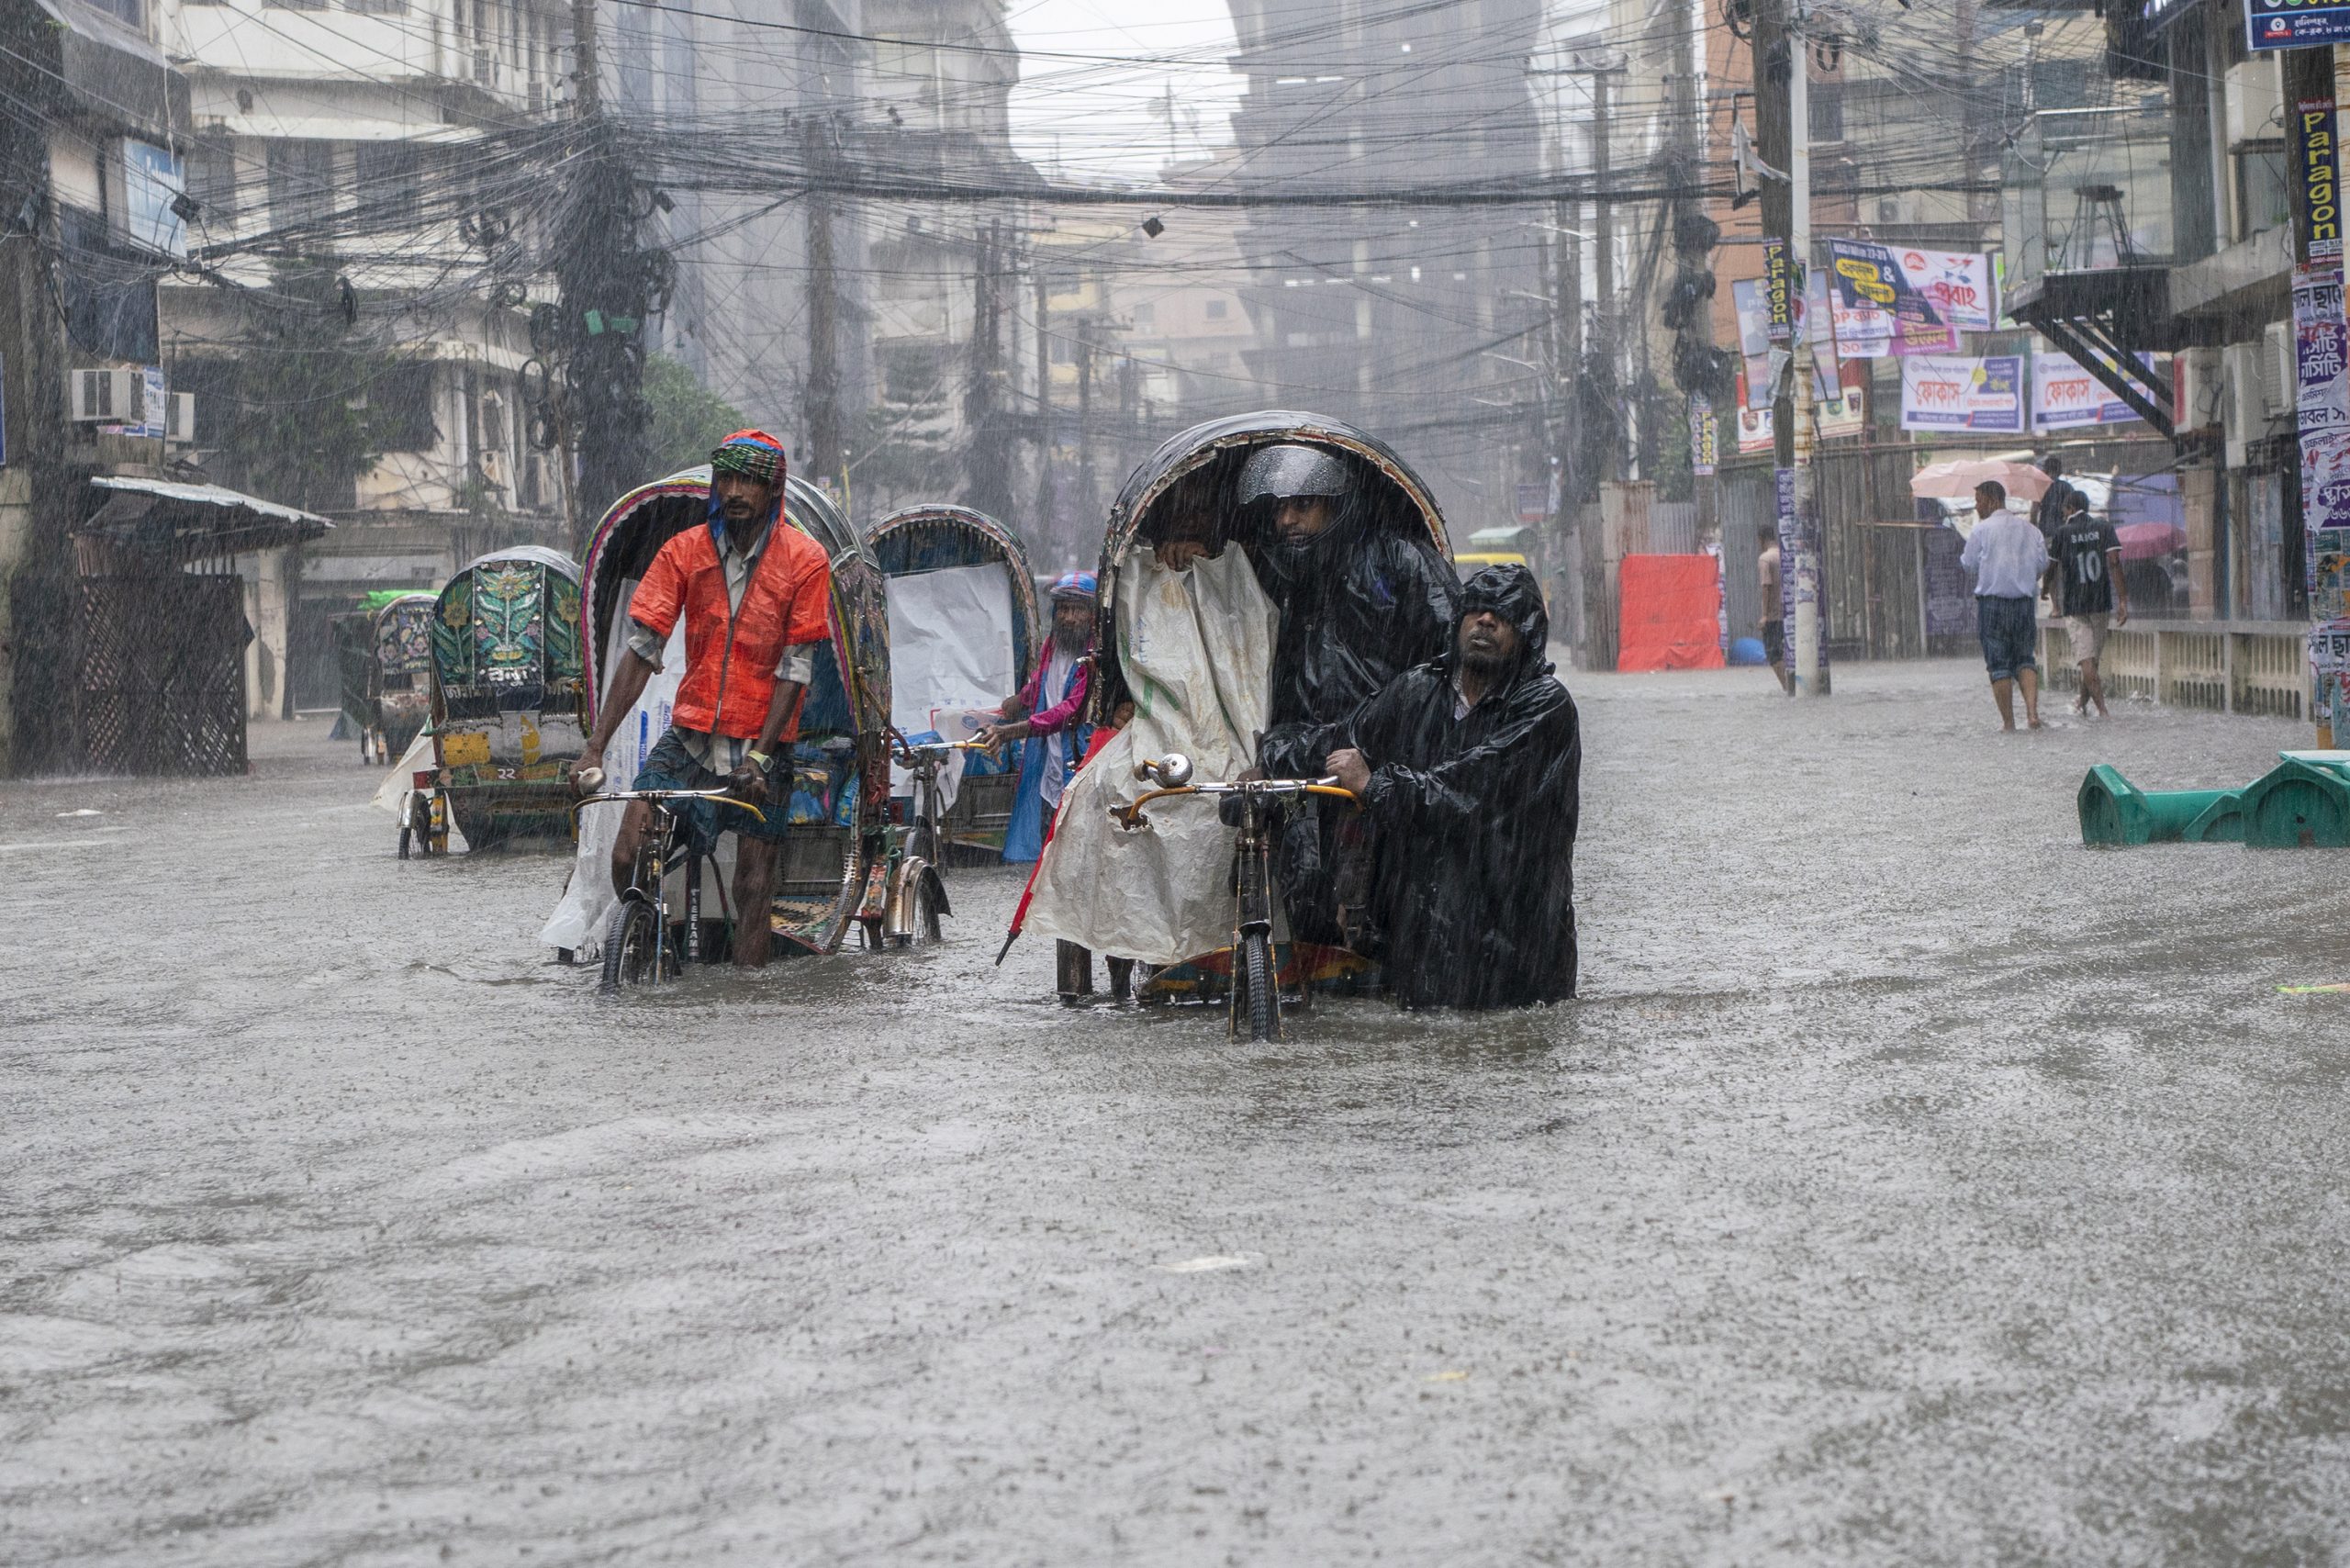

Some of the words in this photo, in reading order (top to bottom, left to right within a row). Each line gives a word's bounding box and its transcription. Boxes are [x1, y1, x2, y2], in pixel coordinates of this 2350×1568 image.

[2303, 112, 2335, 240] Paragon
[1768, 246, 1787, 324] Paragon
[1917, 380, 1961, 407] ফোকাস
[2045, 378, 2091, 407] ফোকাস
[2076, 550, 2101, 584] 10
